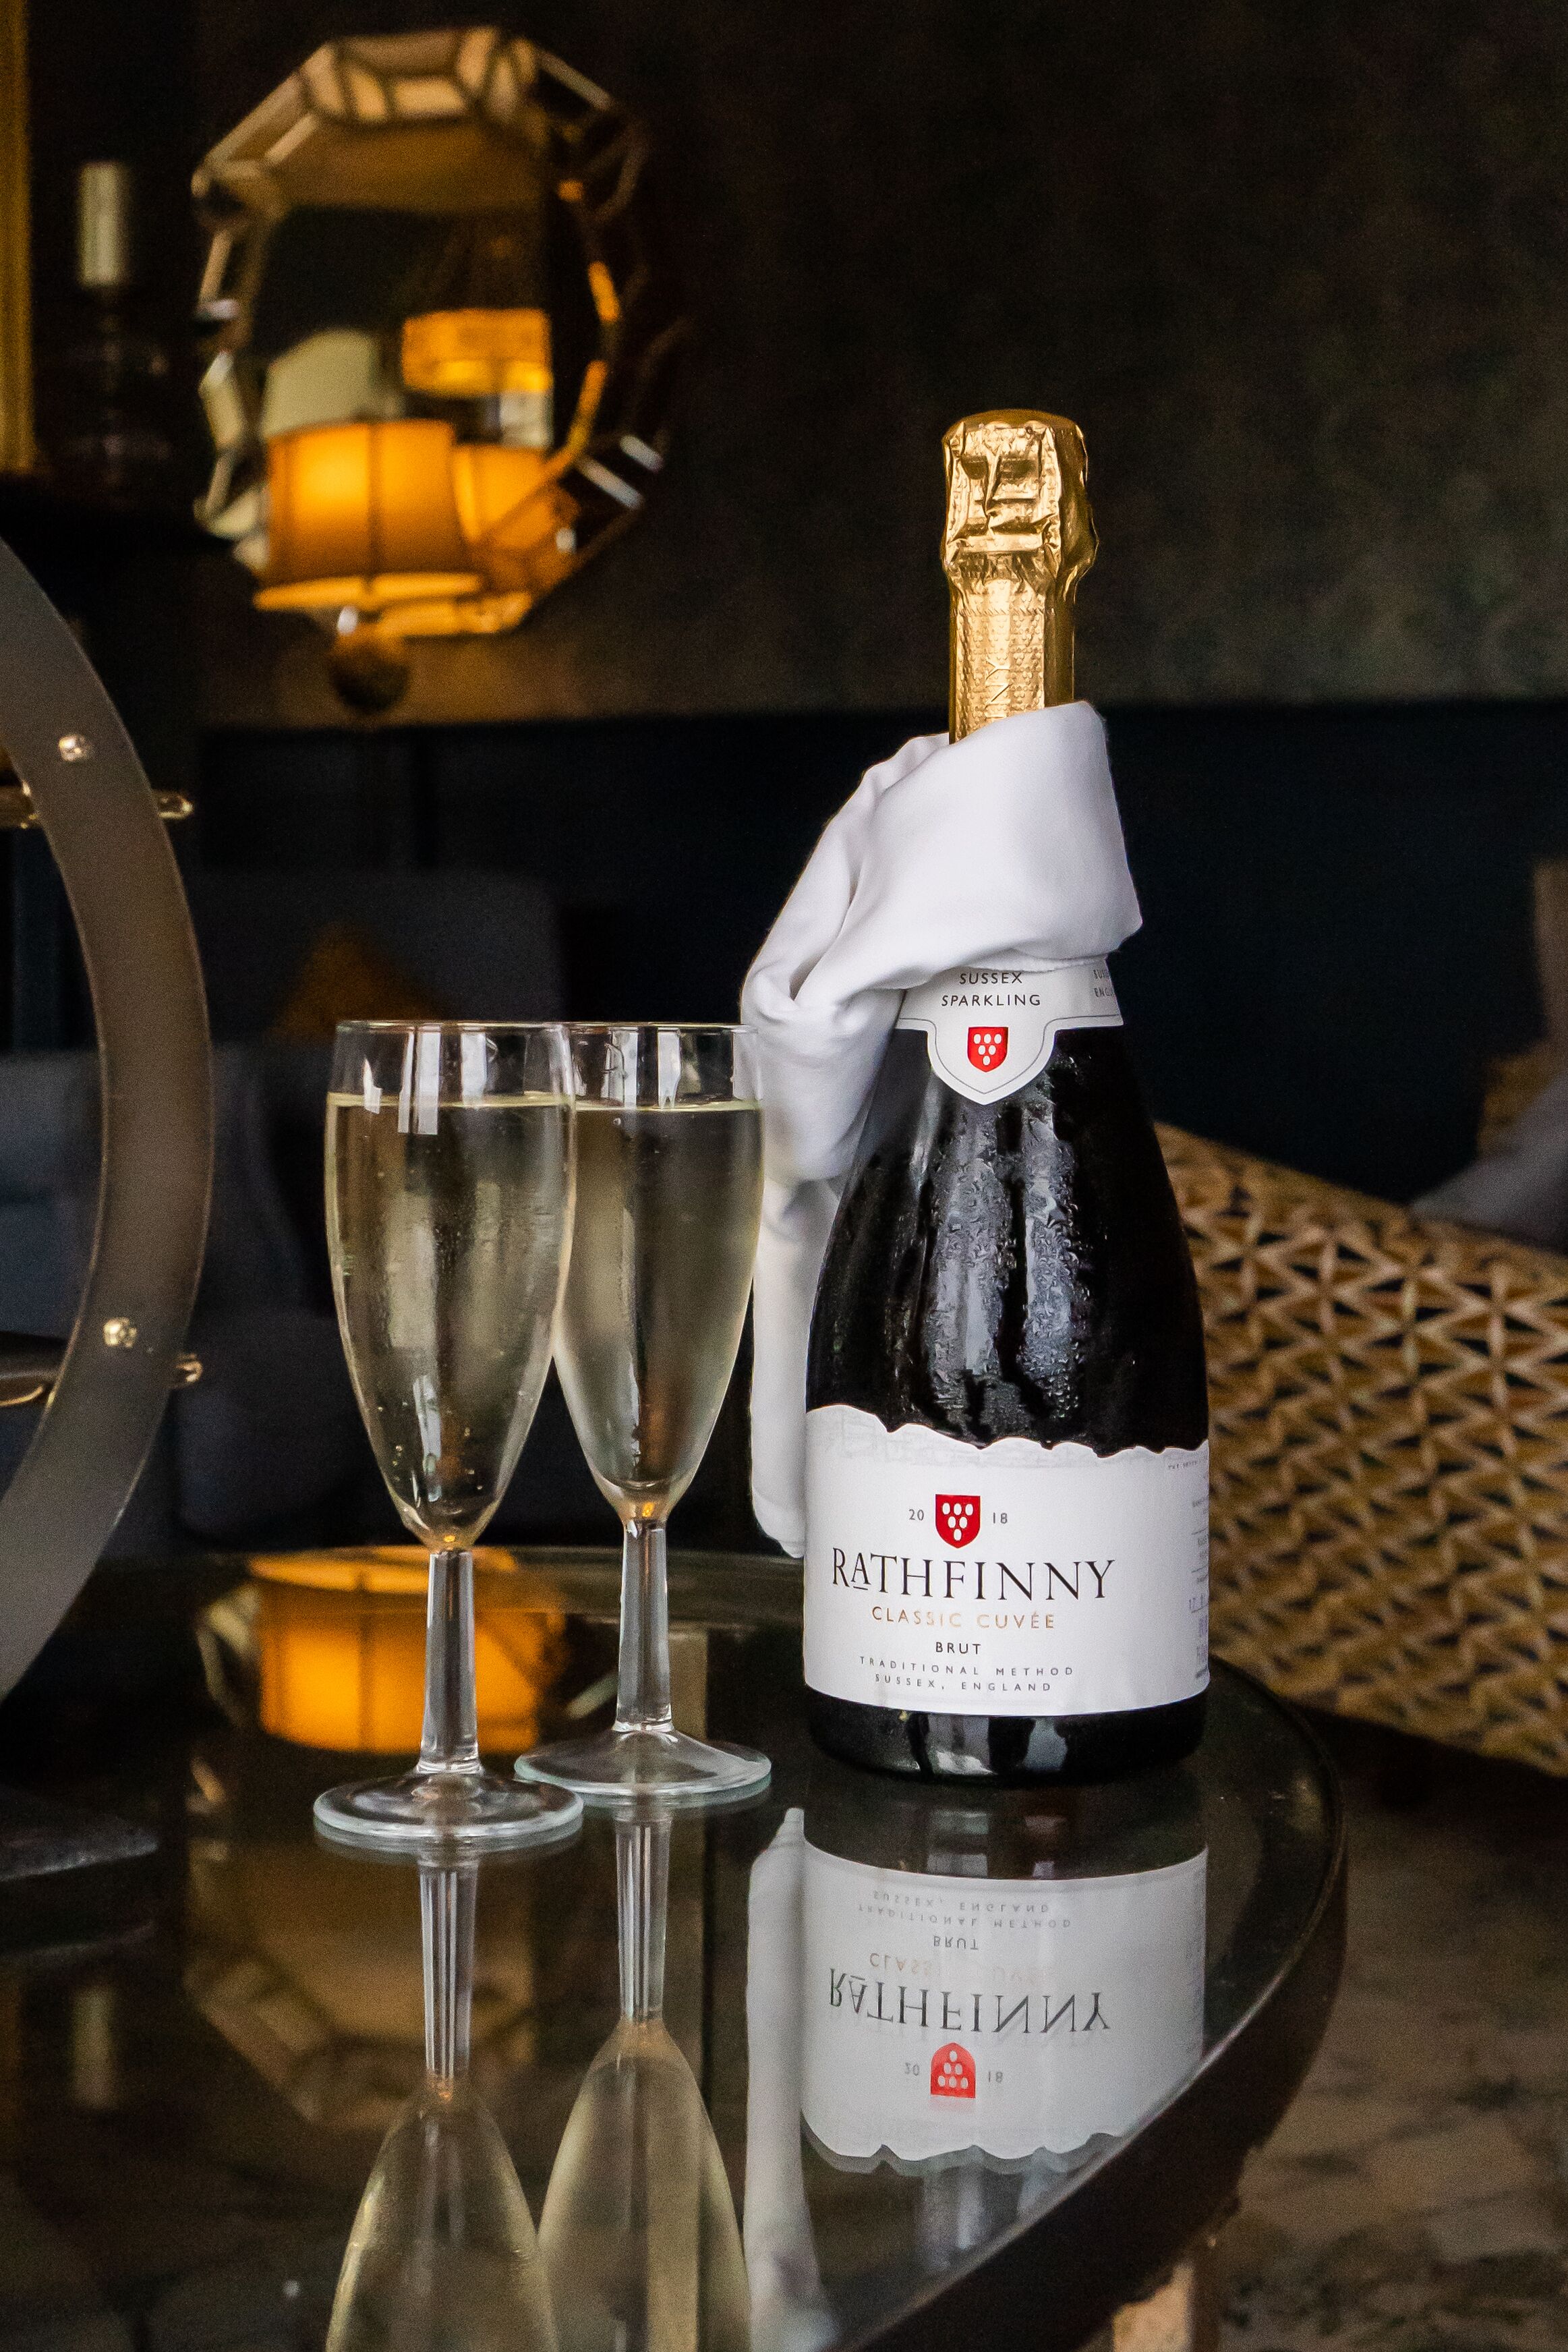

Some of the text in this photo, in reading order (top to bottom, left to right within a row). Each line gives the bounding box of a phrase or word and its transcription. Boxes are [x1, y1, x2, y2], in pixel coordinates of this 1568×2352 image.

[958, 971, 1023, 985] SUSSEX
[941, 994, 1041, 1007] SPARKLING
[908, 1508, 1008, 1524] 20 18
[832, 1547, 1115, 1601] RATHFINNY
[871, 1606, 1055, 1629] CLASSIC CUVÉE
[935, 1641, 981, 1655] BRUT
[860, 1655, 1073, 1676] TRADITIONAL METHOD
[875, 1673, 1051, 1692] SUSSEX, ENGLAND
